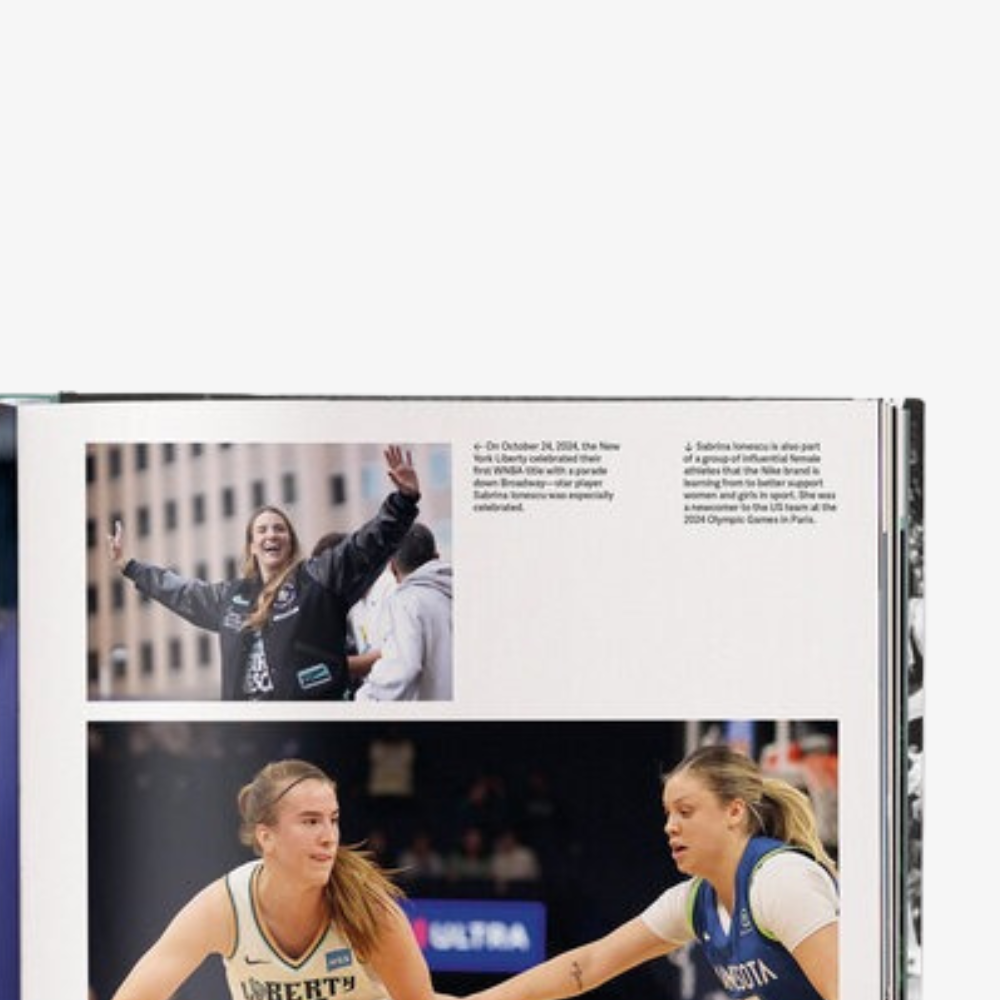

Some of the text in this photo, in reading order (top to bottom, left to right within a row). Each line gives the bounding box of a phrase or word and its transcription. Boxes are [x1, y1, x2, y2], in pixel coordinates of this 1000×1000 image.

[485, 441, 500, 451] On
[501, 441, 539, 451] October
[581, 441, 597, 451] the
[599, 441, 620, 451] New
[696, 441, 821, 453] Sabrina Ionescu is also part
[474, 453, 602, 465] York Liberty celebrated their
[473, 466, 492, 475] first
[493, 466, 523, 475] WNBA
[525, 466, 545, 475] title
[546, 466, 567, 475] with
[575, 466, 608, 478] parade
[684, 466, 820, 475] athletes that the Nike brand is
[473, 478, 499, 487] down
[574, 478, 603, 490] player
[473, 490, 509, 499] Sabrina
[510, 490, 547, 499] Ionescu
[569, 490, 614, 502] especially
[684, 514, 706, 524] 2024
[707, 514, 745, 526] Olympic
[747, 514, 778, 524] Games
[779, 514, 788, 524] in
[428, 919, 531, 953] ULTRA
